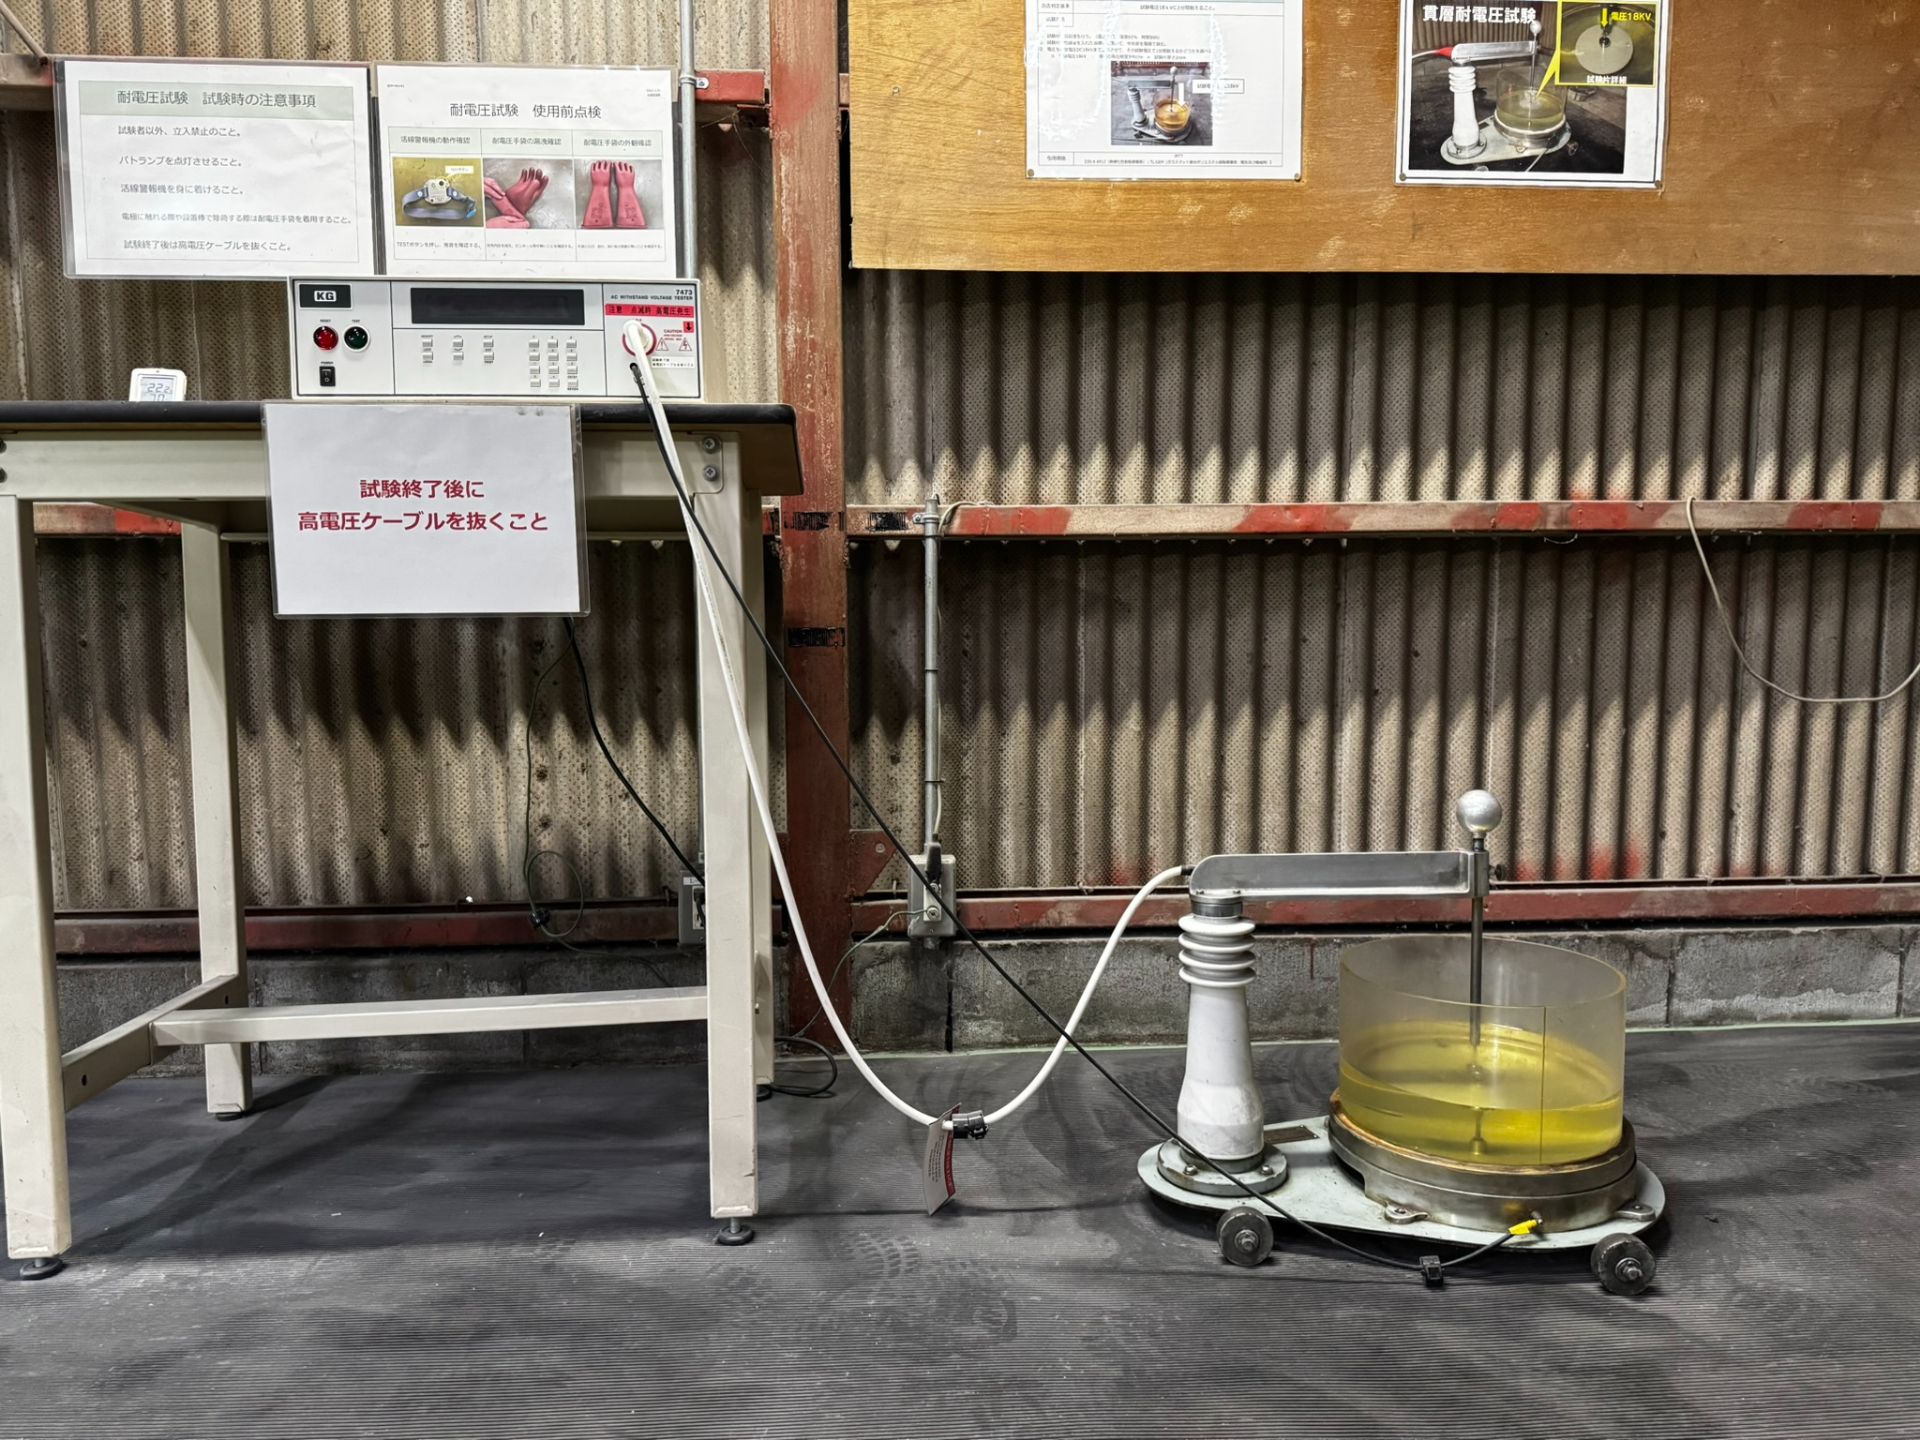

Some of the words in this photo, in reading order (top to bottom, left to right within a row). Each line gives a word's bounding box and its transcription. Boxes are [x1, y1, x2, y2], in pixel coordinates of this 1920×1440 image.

[1422, 5, 1536, 24] 貫層耐電圧試験
[1611, 12, 1653, 22] 電圧18KV
[117, 90, 189, 105] 耐電圧試験
[202, 91, 316, 108] 試験時の注意事項
[450, 103, 520, 118] 耐電圧試験
[532, 103, 602, 119] 使用前点検
[118, 126, 241, 137] 試験者以外、立入禁止のこと。
[124, 240, 291, 251] 試験終了後は高電圧ケーブルを抜くこと。
[316, 291, 335, 300] KG
[359, 479, 486, 499] 試験終了後に
[297, 510, 550, 532] 高電圧ケーブルを抜くこと
